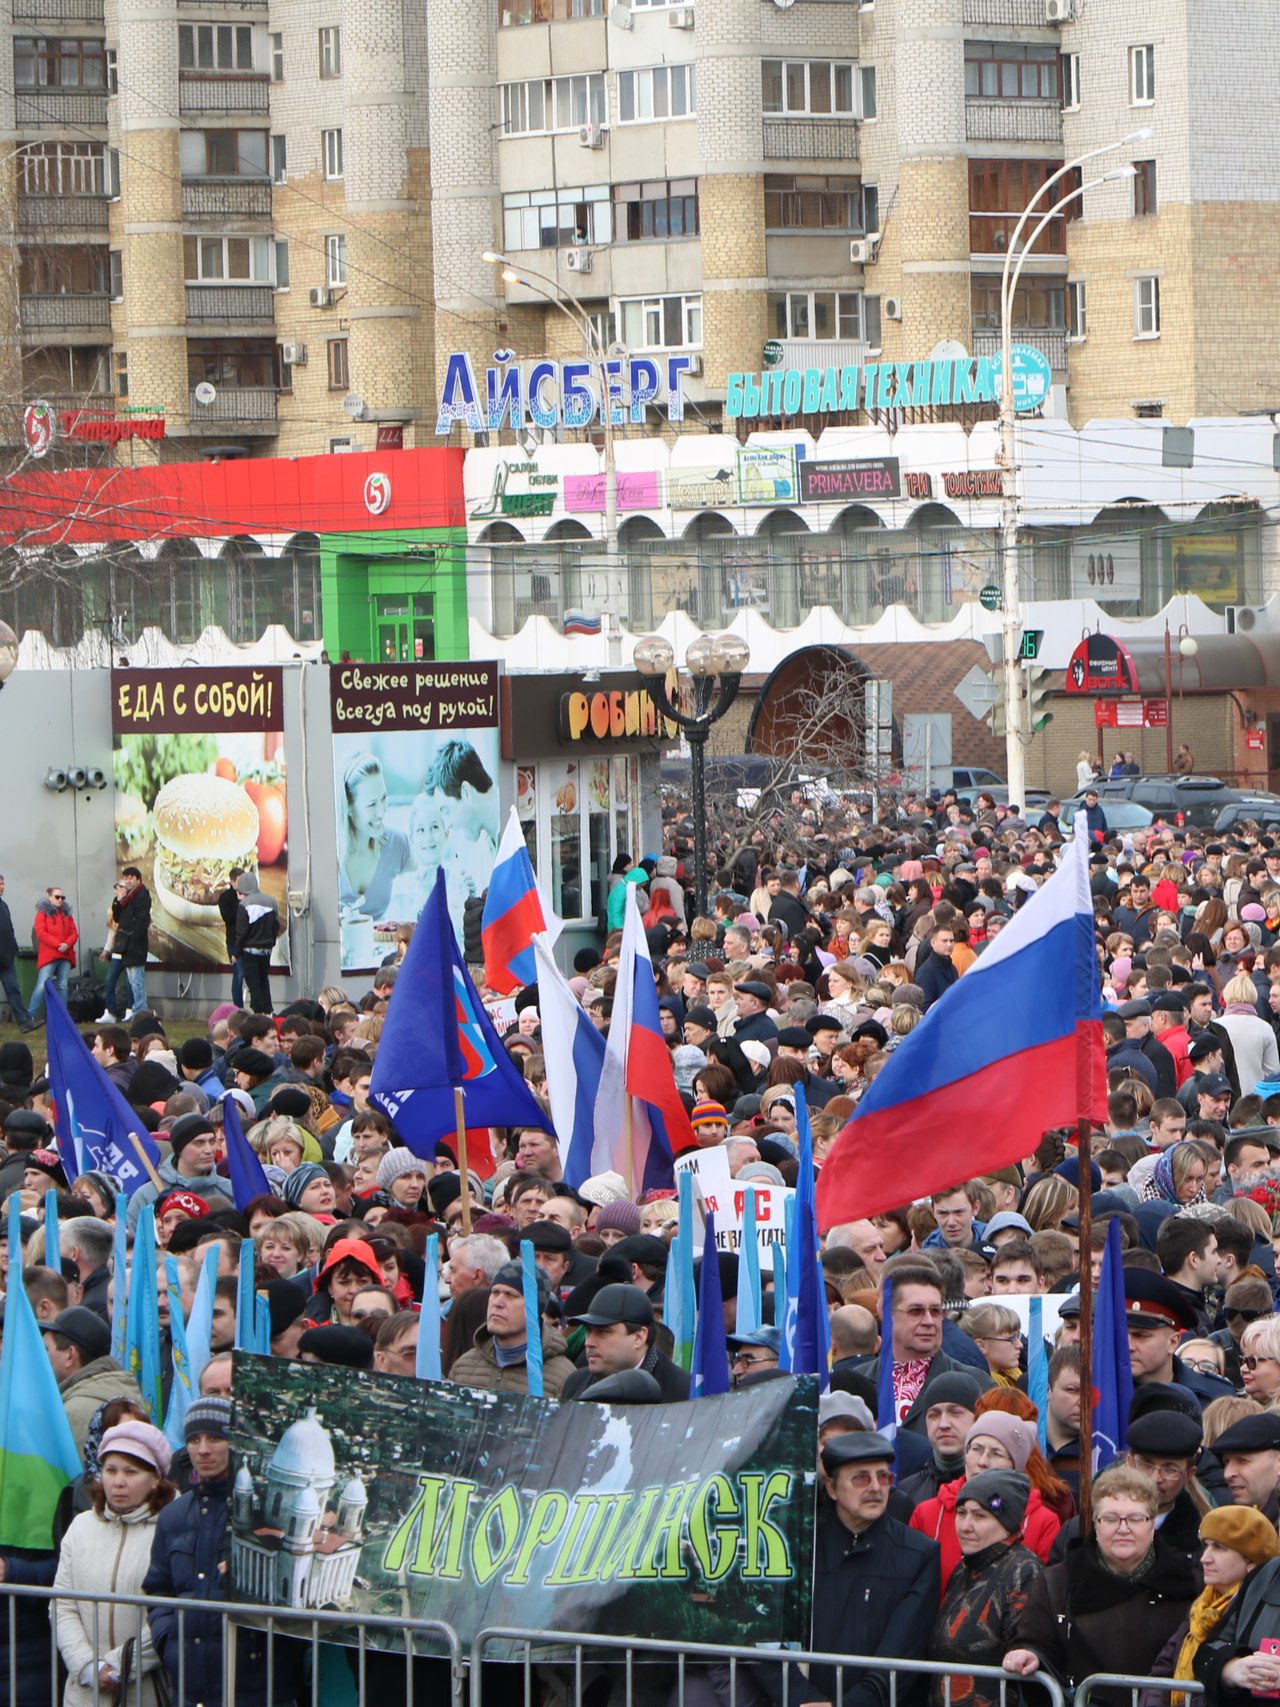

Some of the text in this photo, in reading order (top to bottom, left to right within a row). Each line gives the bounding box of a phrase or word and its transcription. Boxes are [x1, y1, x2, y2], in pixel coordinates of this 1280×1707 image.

[726, 356, 994, 418] БЫТОВАЯ ТЕХНИКА
[808, 471, 894, 494] PRIMAVERA
[904, 473, 928, 494] ТРИ
[119, 671, 273, 721] ЕДА С СОБОЙ!
[341, 670, 489, 692] Свежее решение
[336, 695, 494, 726] всегда под рукой!
[383, 1472, 793, 1587] МОРШАНСК
